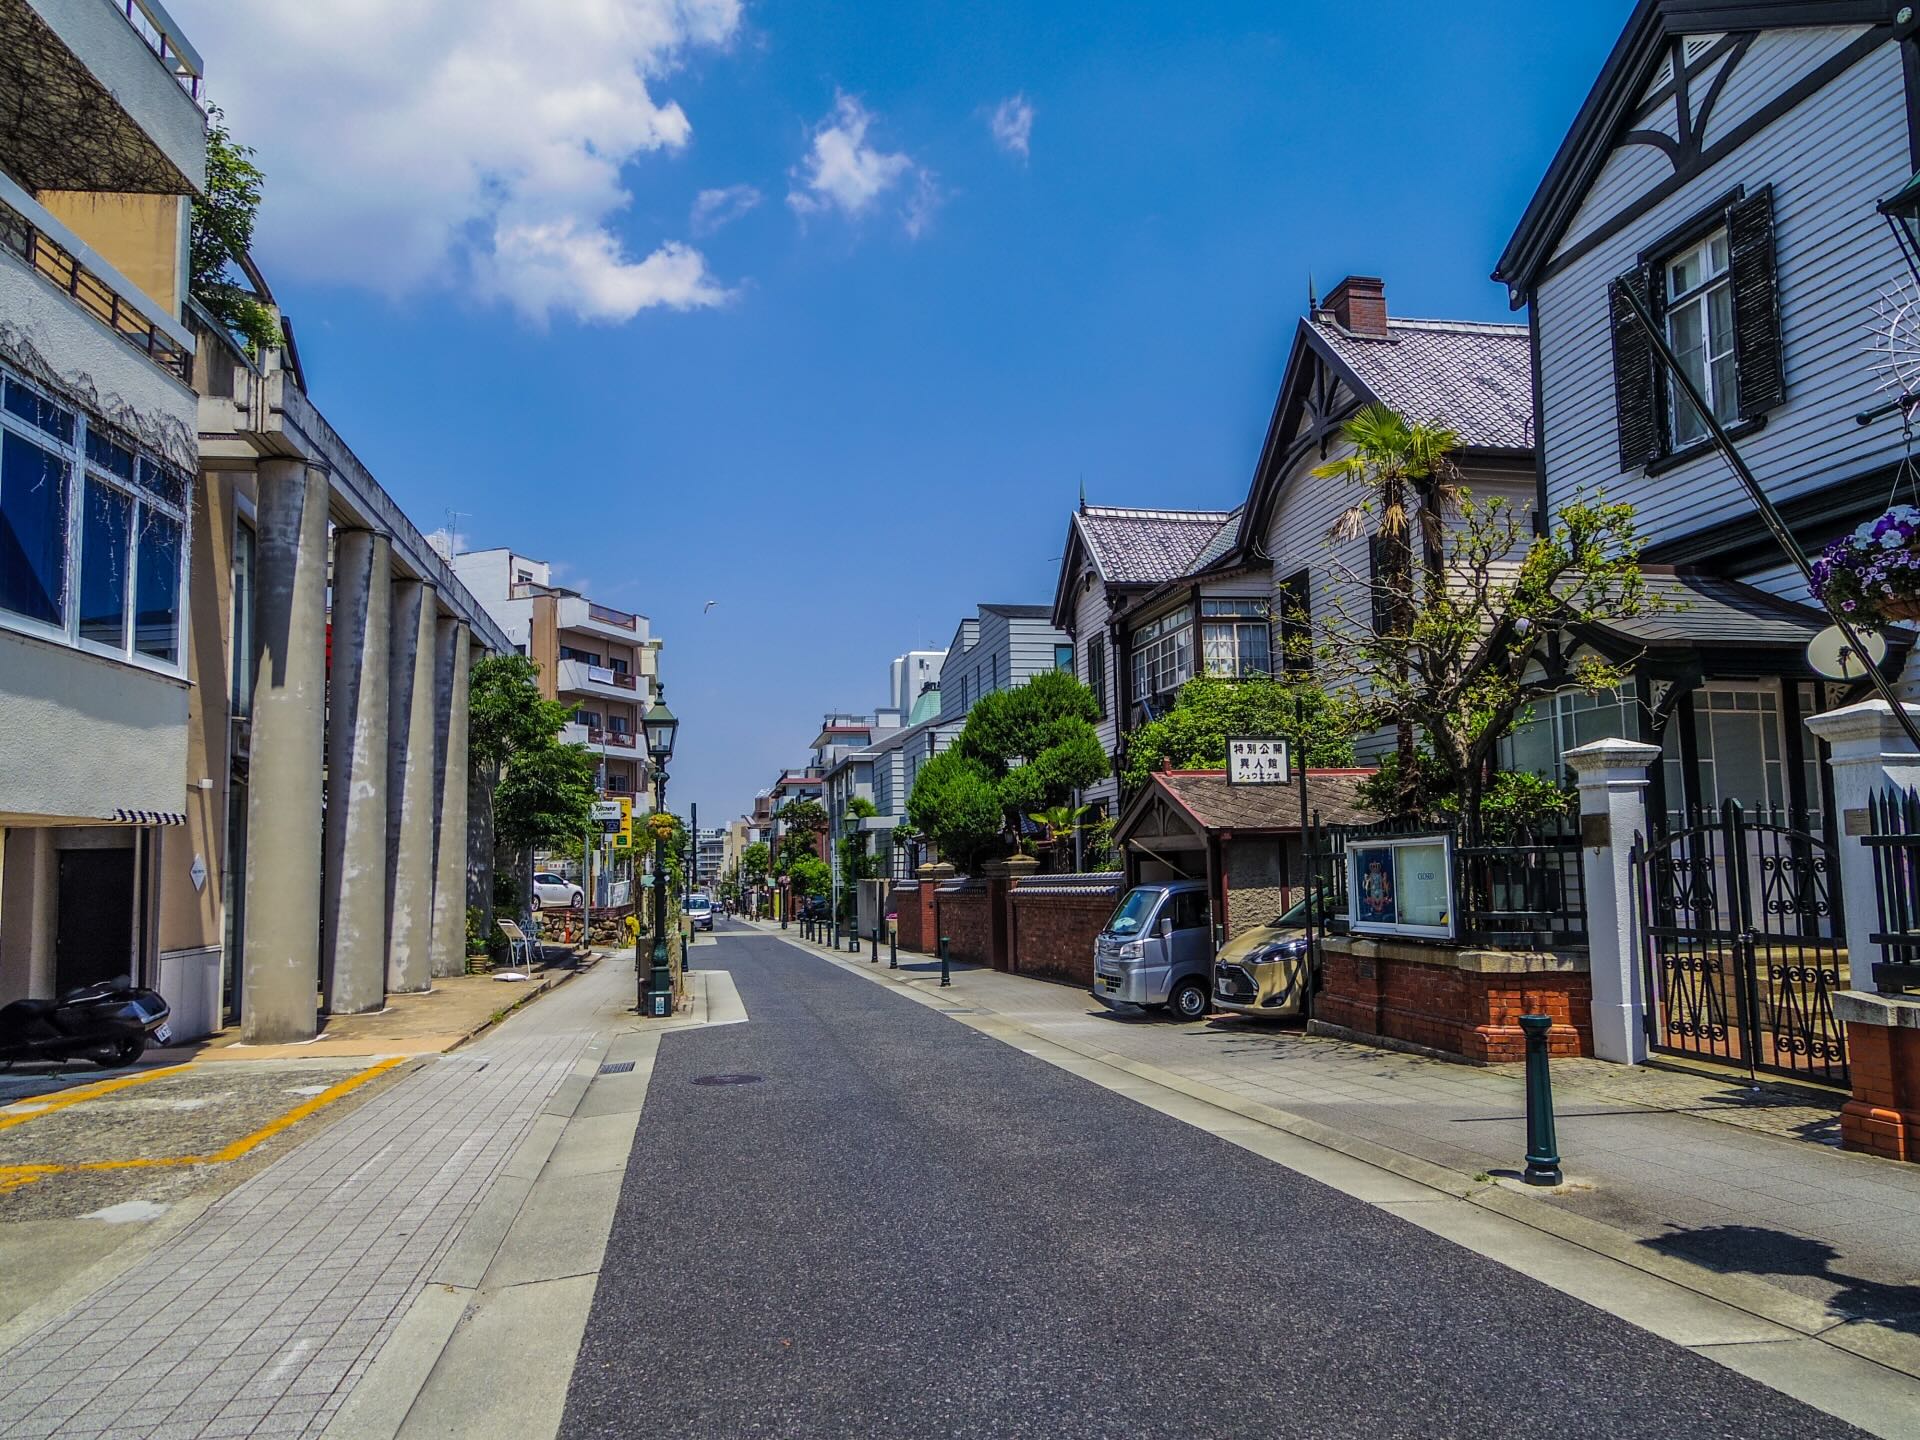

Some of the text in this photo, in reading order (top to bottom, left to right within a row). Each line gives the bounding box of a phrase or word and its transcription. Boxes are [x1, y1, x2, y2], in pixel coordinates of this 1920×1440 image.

[1233, 743, 1283, 755] 特別公開
[1240, 758, 1278, 769] 異人館
